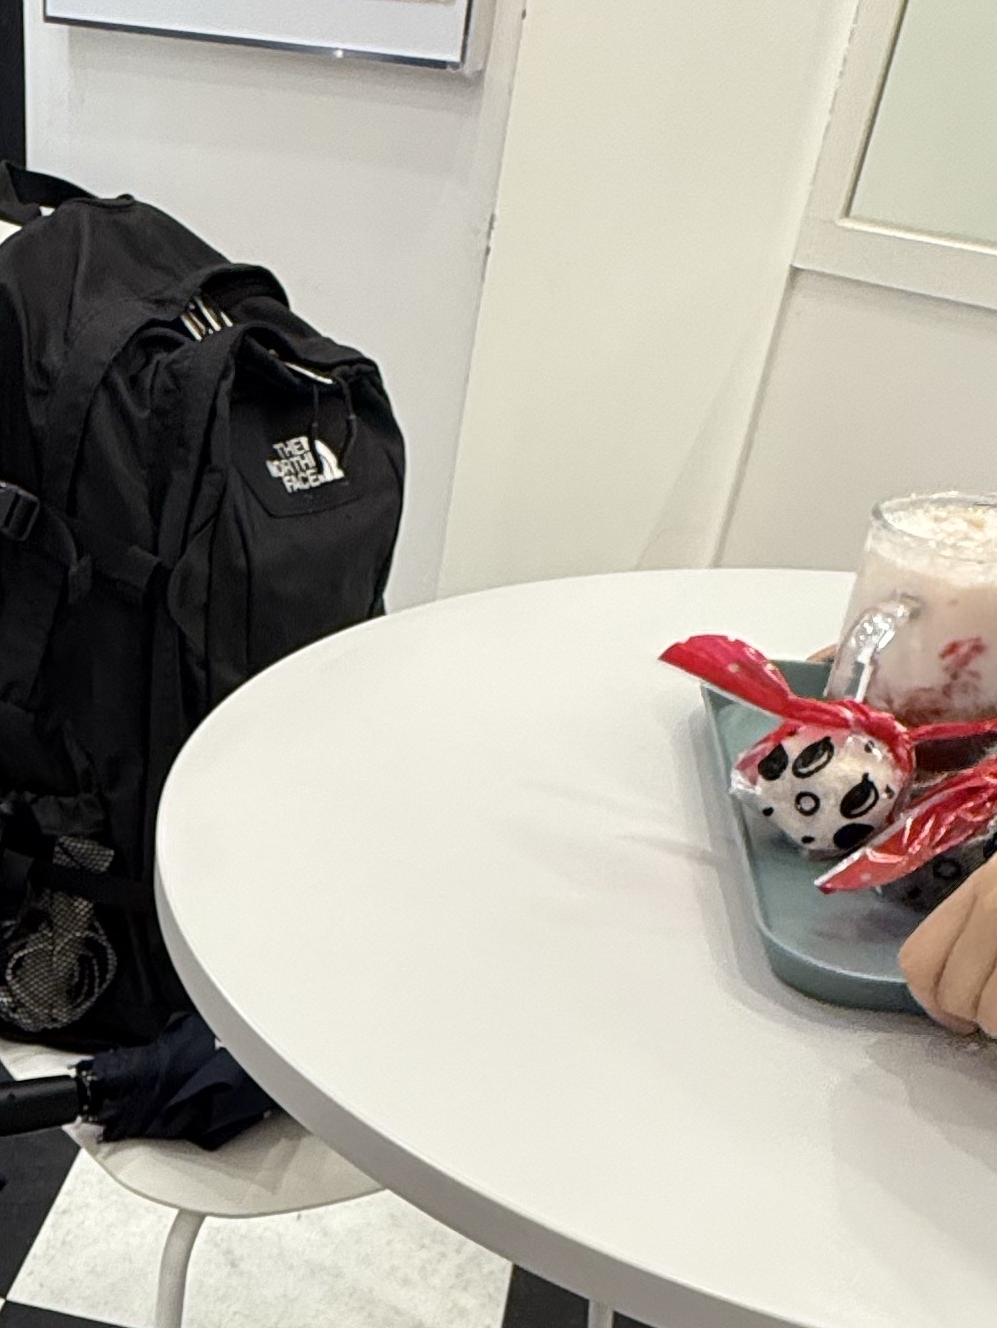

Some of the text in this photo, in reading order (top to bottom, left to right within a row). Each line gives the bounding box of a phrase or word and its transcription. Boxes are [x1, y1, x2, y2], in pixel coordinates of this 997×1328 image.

[273, 436, 310, 458] THE
[266, 451, 317, 478] NORTH
[282, 469, 321, 493] FACE
